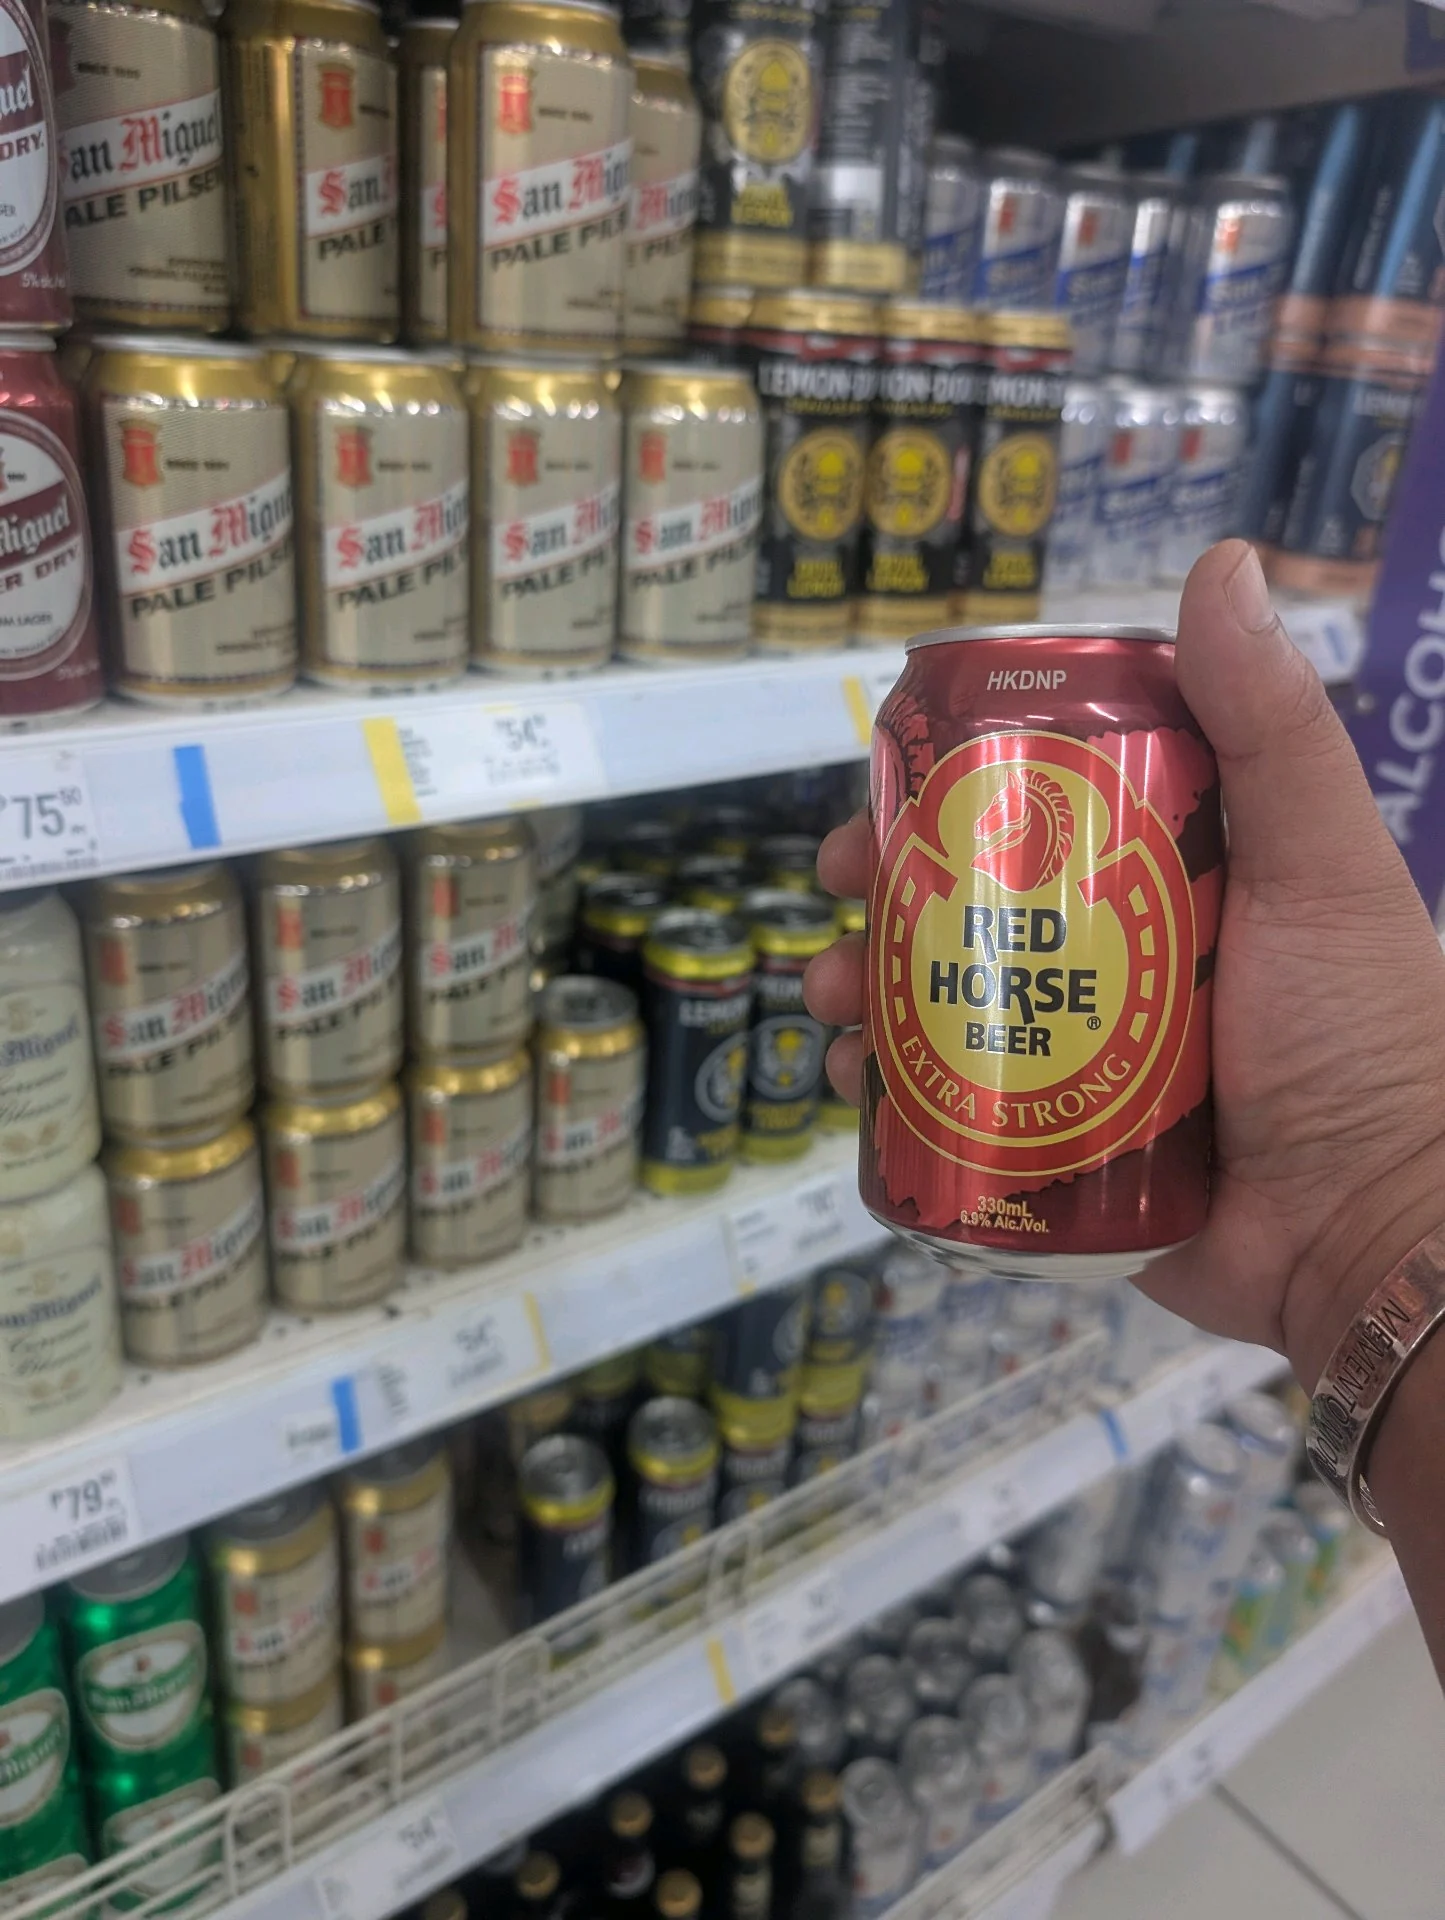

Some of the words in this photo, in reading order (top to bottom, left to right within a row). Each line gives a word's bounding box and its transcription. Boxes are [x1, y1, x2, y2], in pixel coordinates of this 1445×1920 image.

[65, 193, 128, 229] ALE
[318, 170, 380, 217] San
[491, 177, 562, 225] San
[129, 528, 201, 575] San
[336, 526, 405, 570] San
[503, 522, 567, 562] San
[634, 518, 692, 555] San
[131, 581, 215, 620] PALE
[336, 571, 415, 612] PALE
[986, 669, 1067, 691] HKDNP
[1375, 525, 1445, 843] ALCO
[962, 904, 1067, 966] RED
[928, 960, 1098, 1026] HORSE
[964, 1020, 1052, 1057] BEER
[902, 1035, 976, 1121] EXTRA
[991, 1053, 1131, 1129] STRONG
[960, 1209, 991, 1228] 6.9%
[993, 1215, 1050, 1233] Alc./Vol.
[977, 1195, 1033, 1218] 330mL
[1327, 1298, 1411, 1426] MEMENTO
